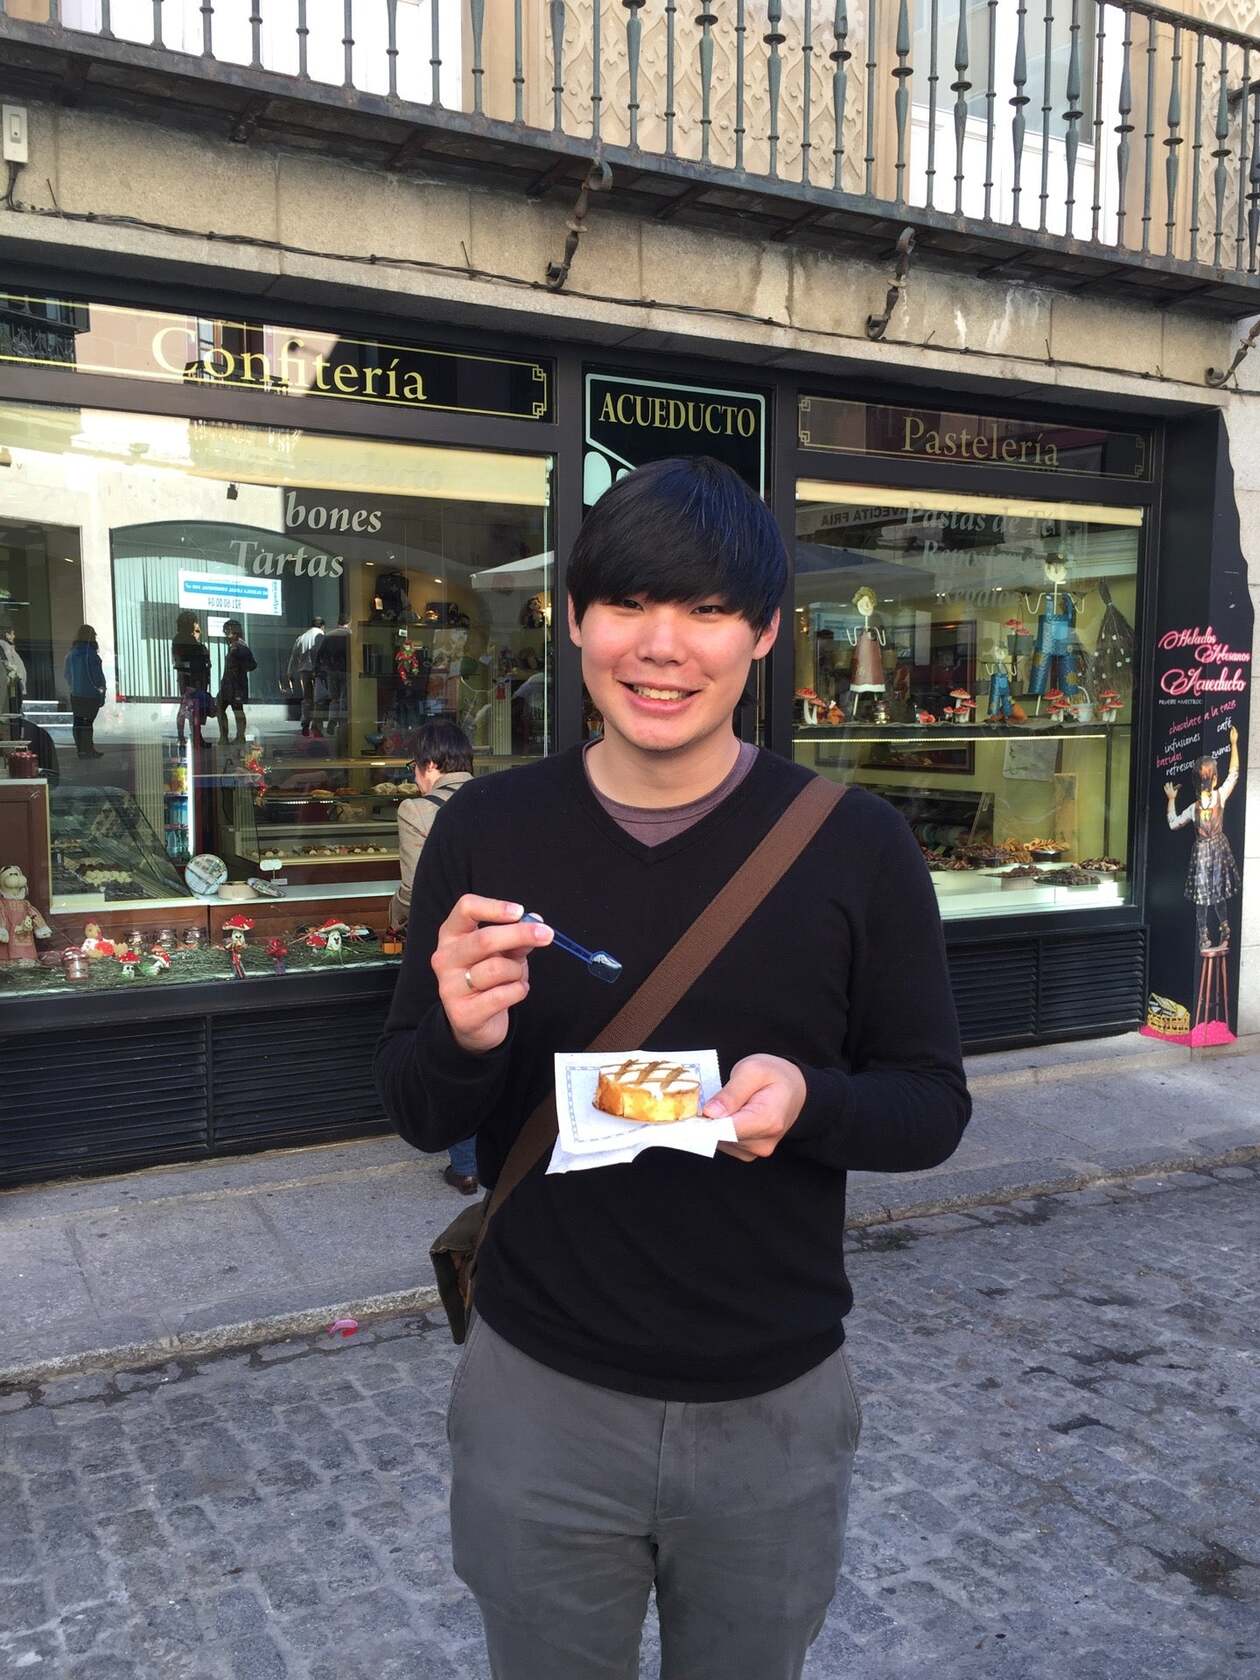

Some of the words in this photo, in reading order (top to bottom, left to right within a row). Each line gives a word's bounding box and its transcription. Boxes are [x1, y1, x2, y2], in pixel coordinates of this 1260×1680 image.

[151, 326, 427, 400] Confitería
[598, 392, 755, 438] ACUEDUCTO
[901, 416, 1060, 466] Pastelería
[906, 500, 986, 532] Pastas
[229, 540, 344, 578] Tartas
[1160, 666, 1246, 696] Acueducto
